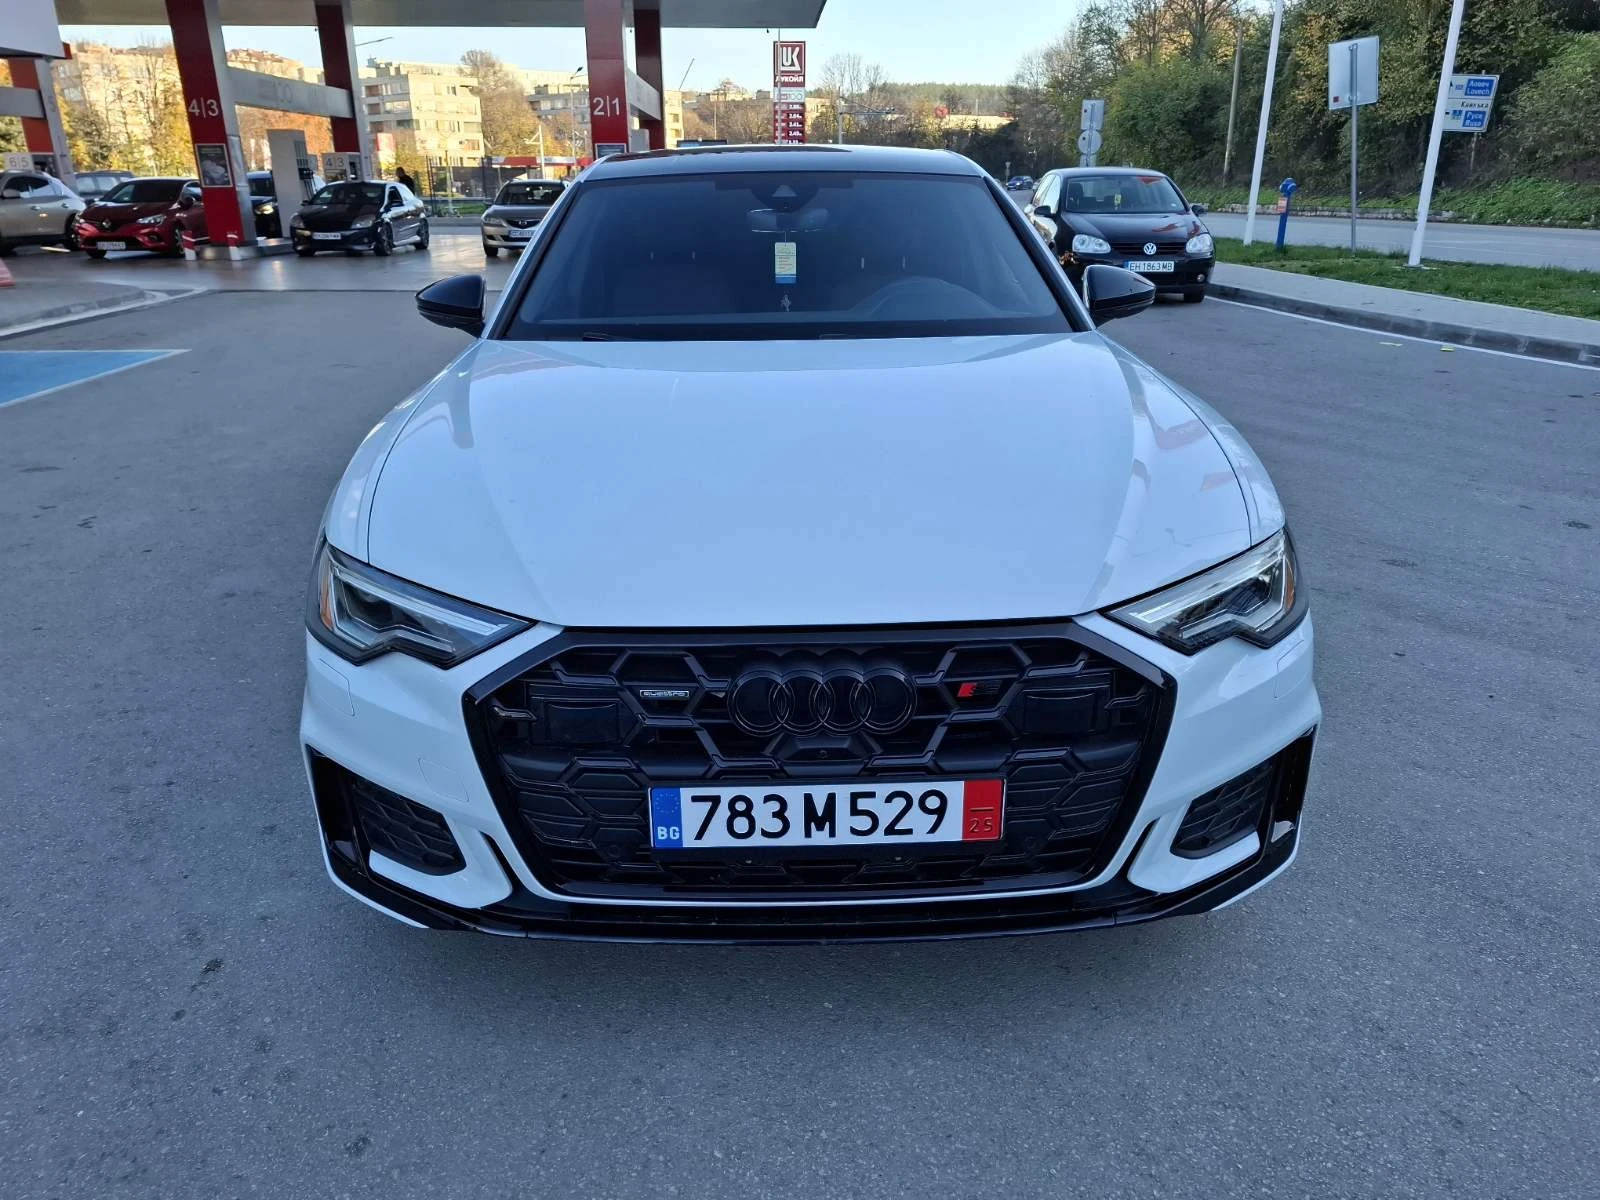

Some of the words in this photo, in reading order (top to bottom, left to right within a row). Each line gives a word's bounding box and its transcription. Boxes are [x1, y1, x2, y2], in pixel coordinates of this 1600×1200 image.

[1143, 262, 1161, 271] 1863
[657, 826, 680, 839] BG
[691, 794, 791, 841] 783
[803, 792, 837, 838] M
[849, 789, 948, 837] 529
[968, 817, 993, 833] 25
